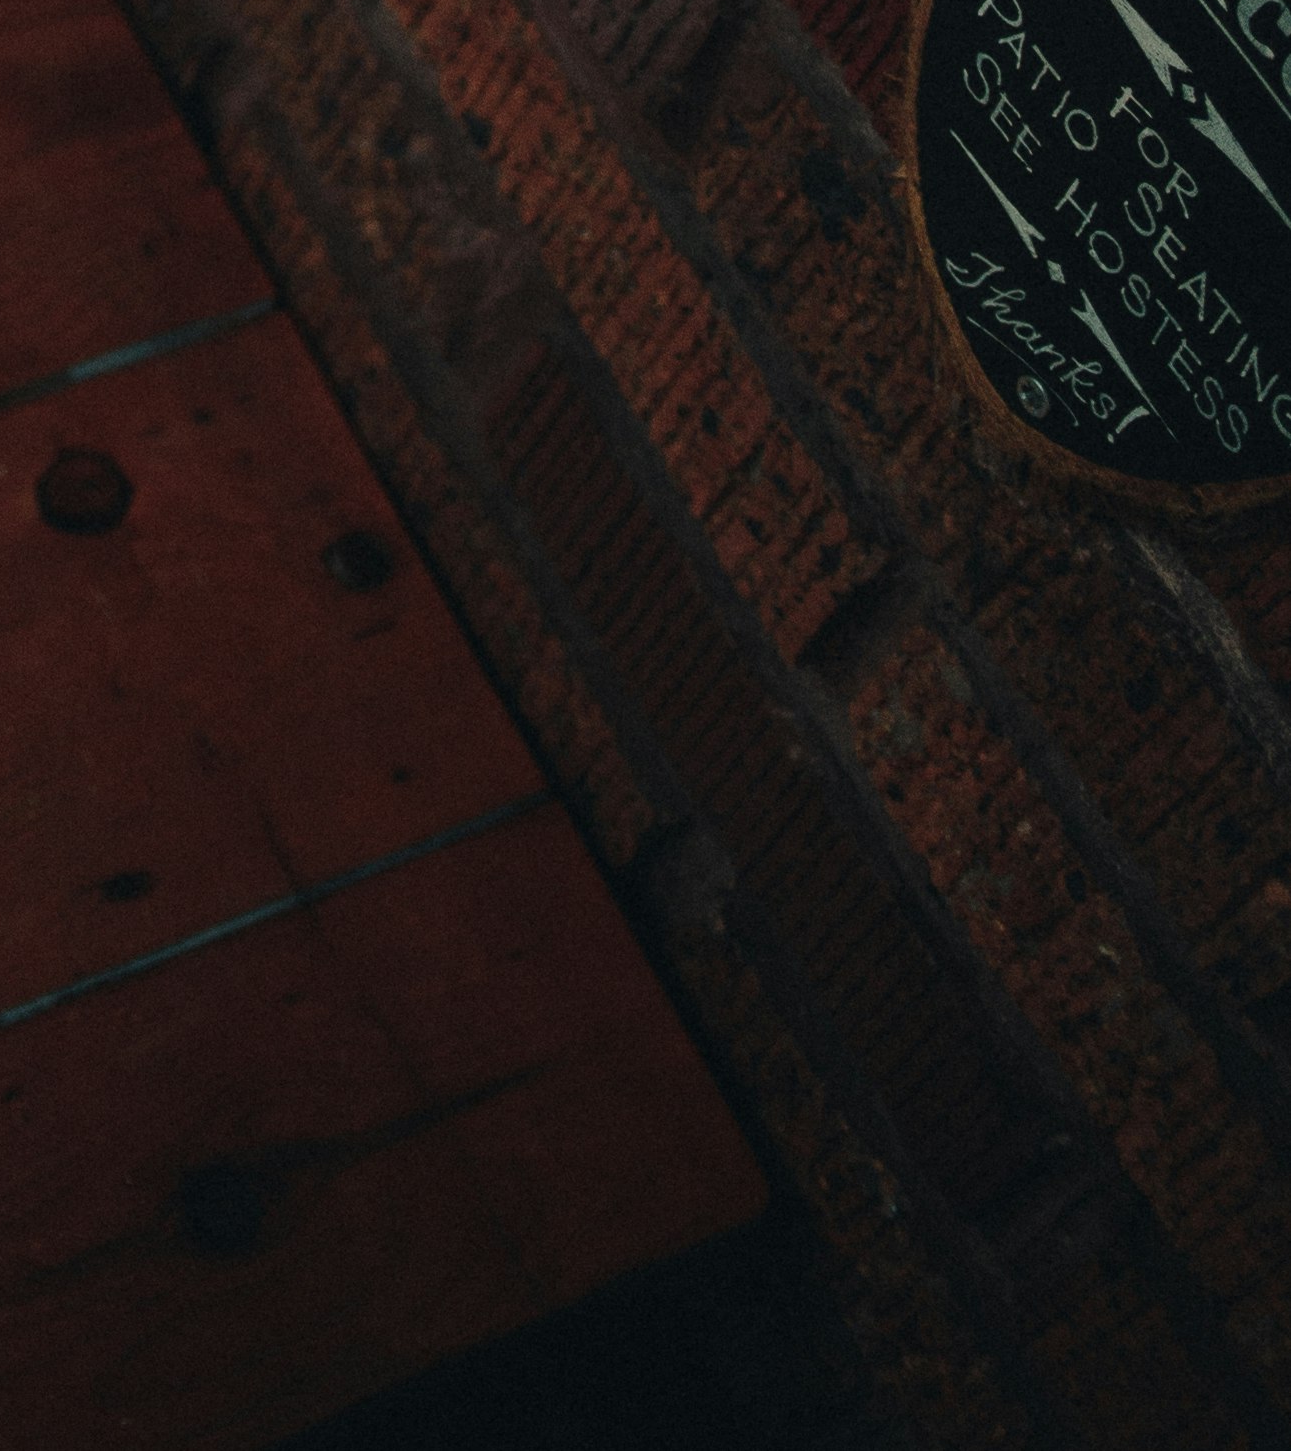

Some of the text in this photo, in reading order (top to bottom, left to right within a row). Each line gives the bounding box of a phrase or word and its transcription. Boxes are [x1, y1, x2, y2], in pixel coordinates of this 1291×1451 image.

[1110, 85, 1200, 220] FOR
[945, 251, 1151, 444] Thanks!
[963, 52, 1249, 453] SEE HOSTESS
